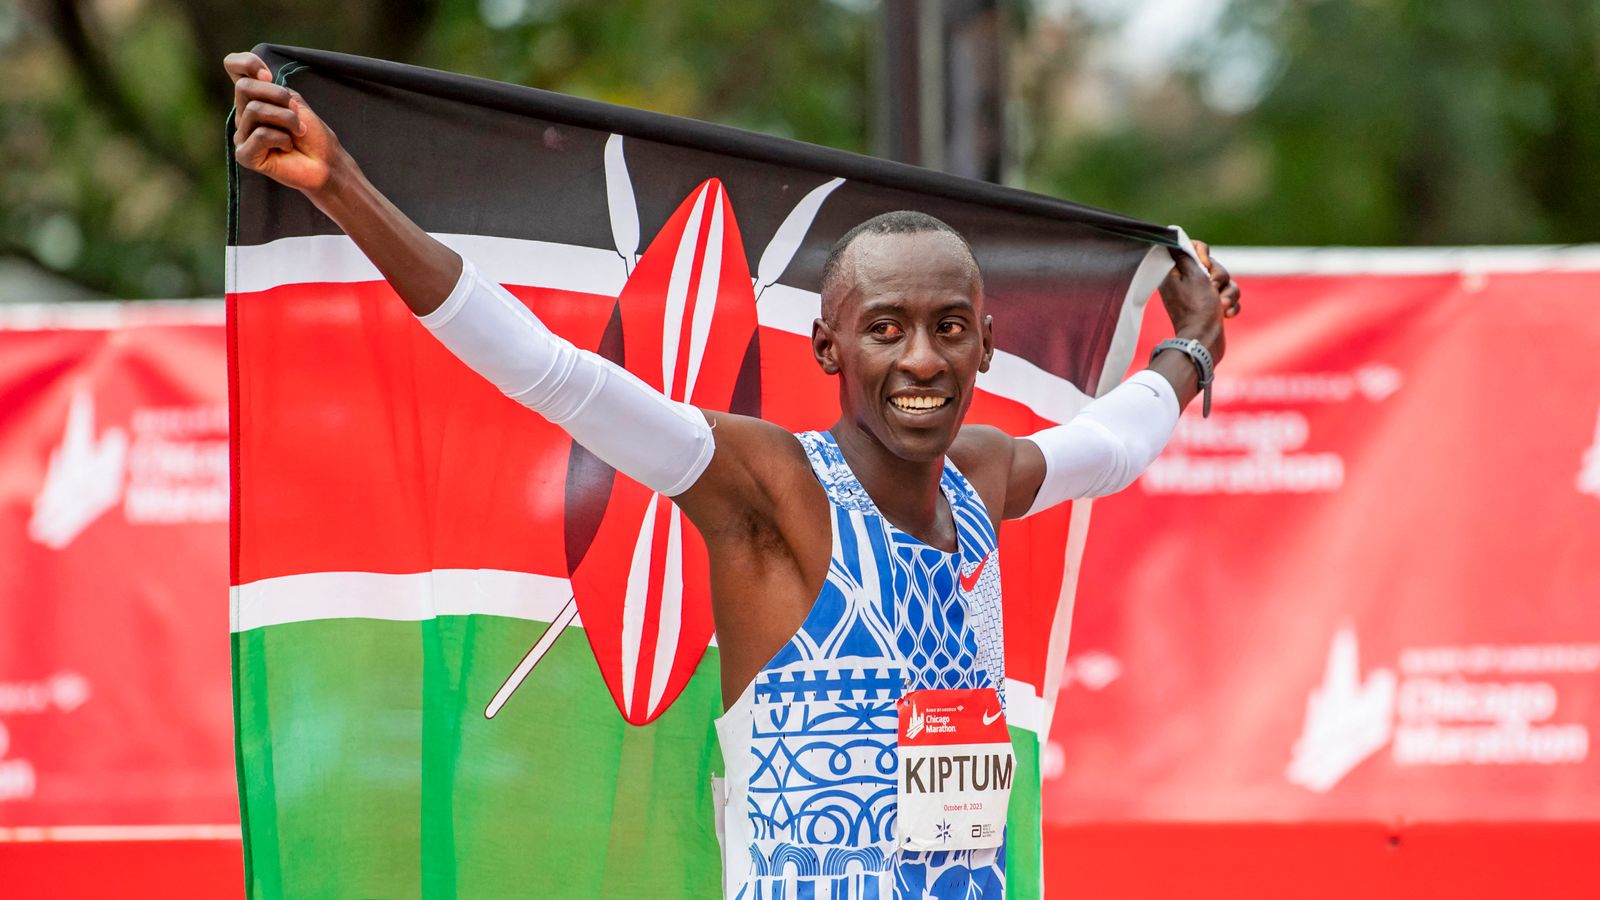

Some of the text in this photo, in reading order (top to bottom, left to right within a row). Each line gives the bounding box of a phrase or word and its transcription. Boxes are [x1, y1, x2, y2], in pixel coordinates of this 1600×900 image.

[926, 715, 950, 725] Chicago
[926, 724, 956, 733] Marathon
[906, 754, 1012, 793] KIPTUM
[969, 802, 983, 810] 2023
